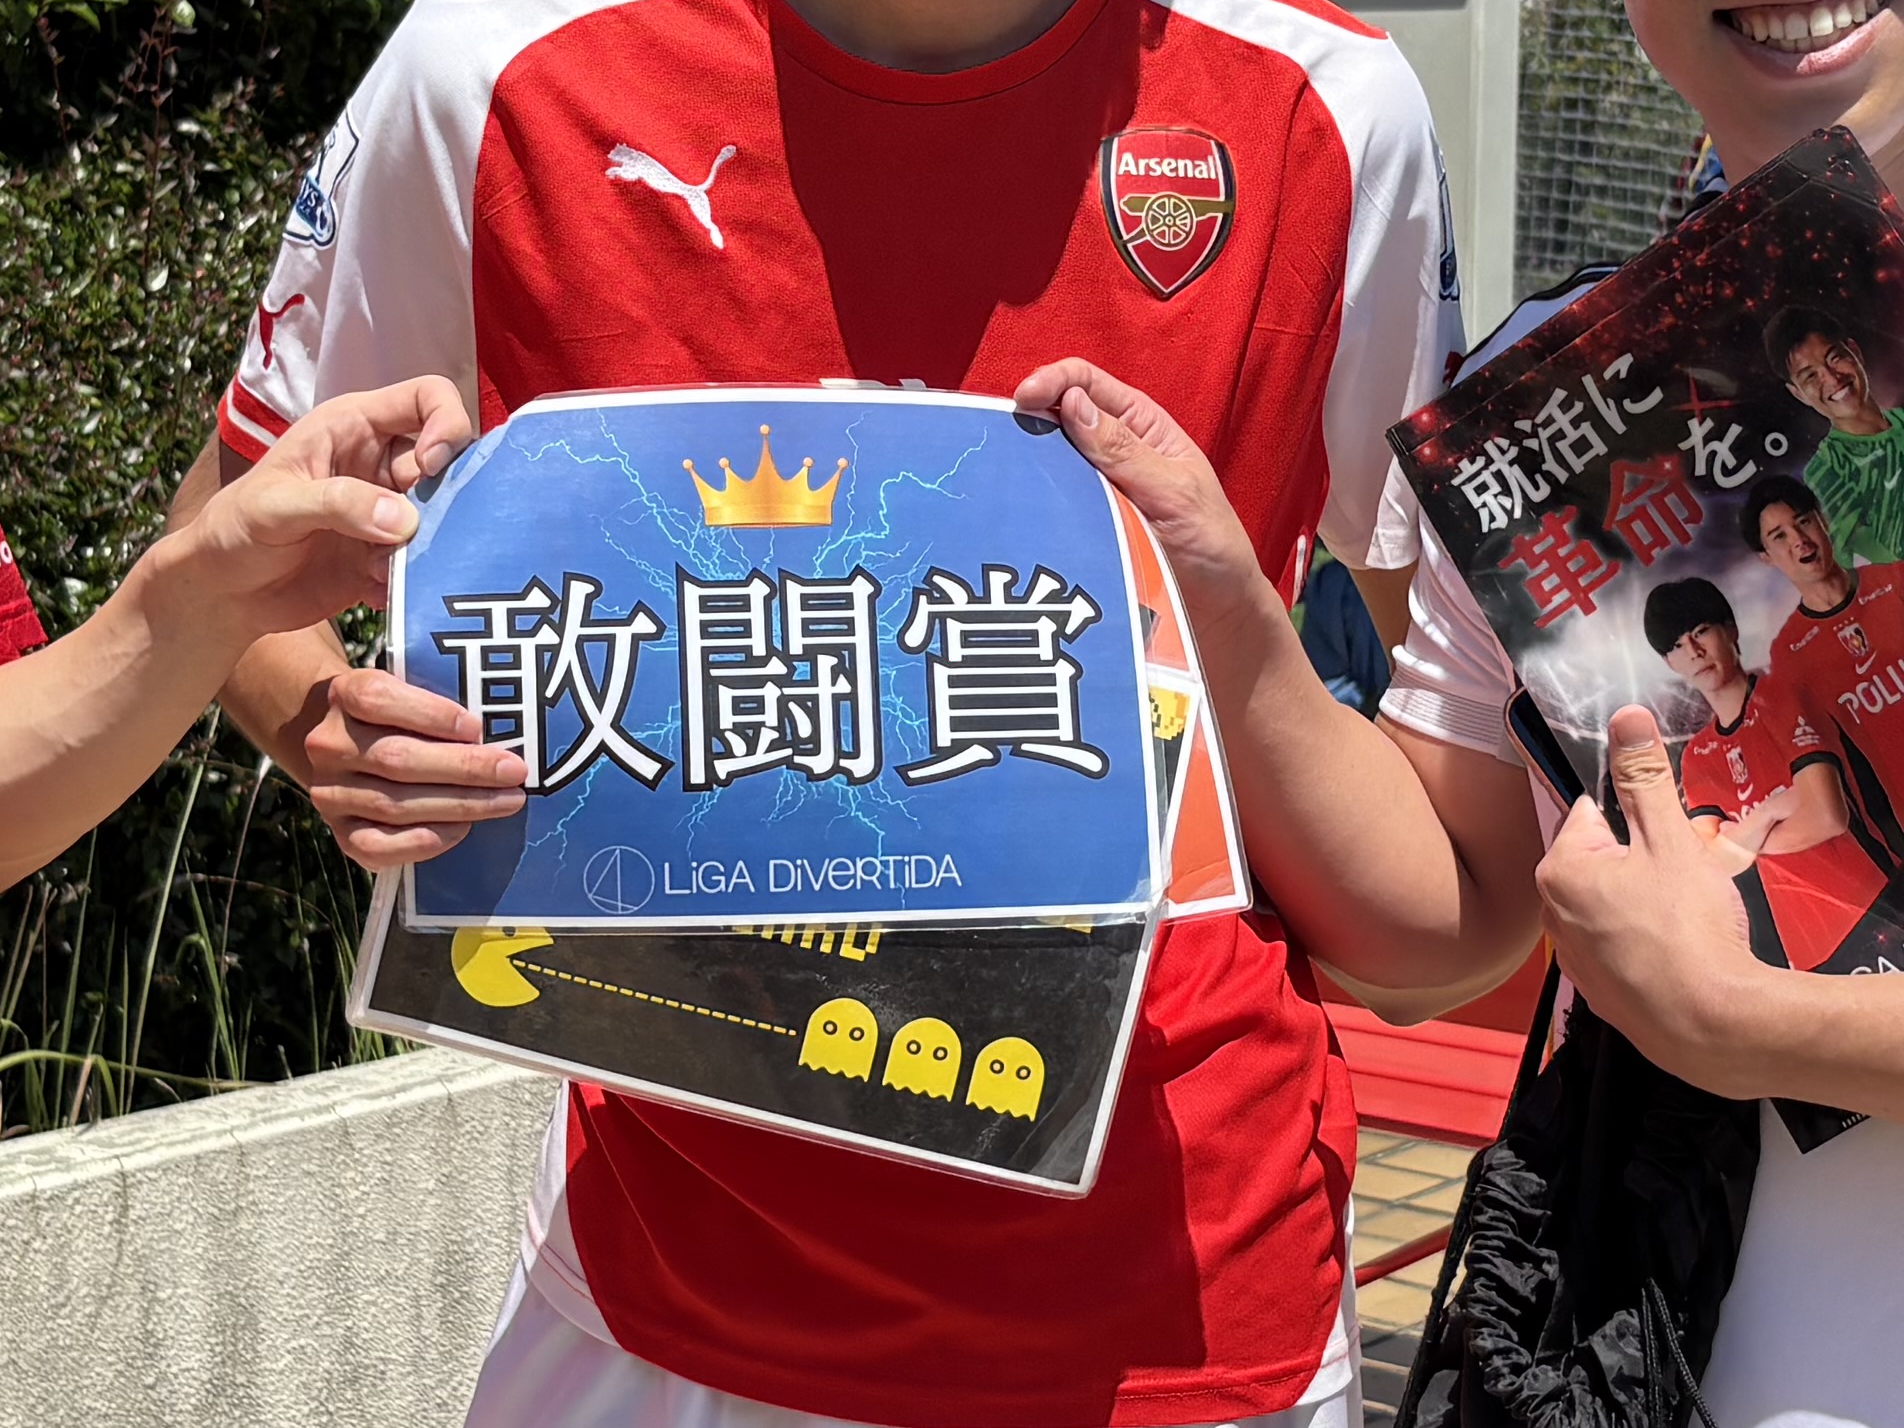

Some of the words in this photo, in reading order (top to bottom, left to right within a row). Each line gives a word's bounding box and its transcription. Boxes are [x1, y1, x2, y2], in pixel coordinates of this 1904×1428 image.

[1117, 151, 1217, 180] Arsenal
[1450, 353, 1664, 533] 就活に
[433, 564, 1107, 793] 敢闘賞
